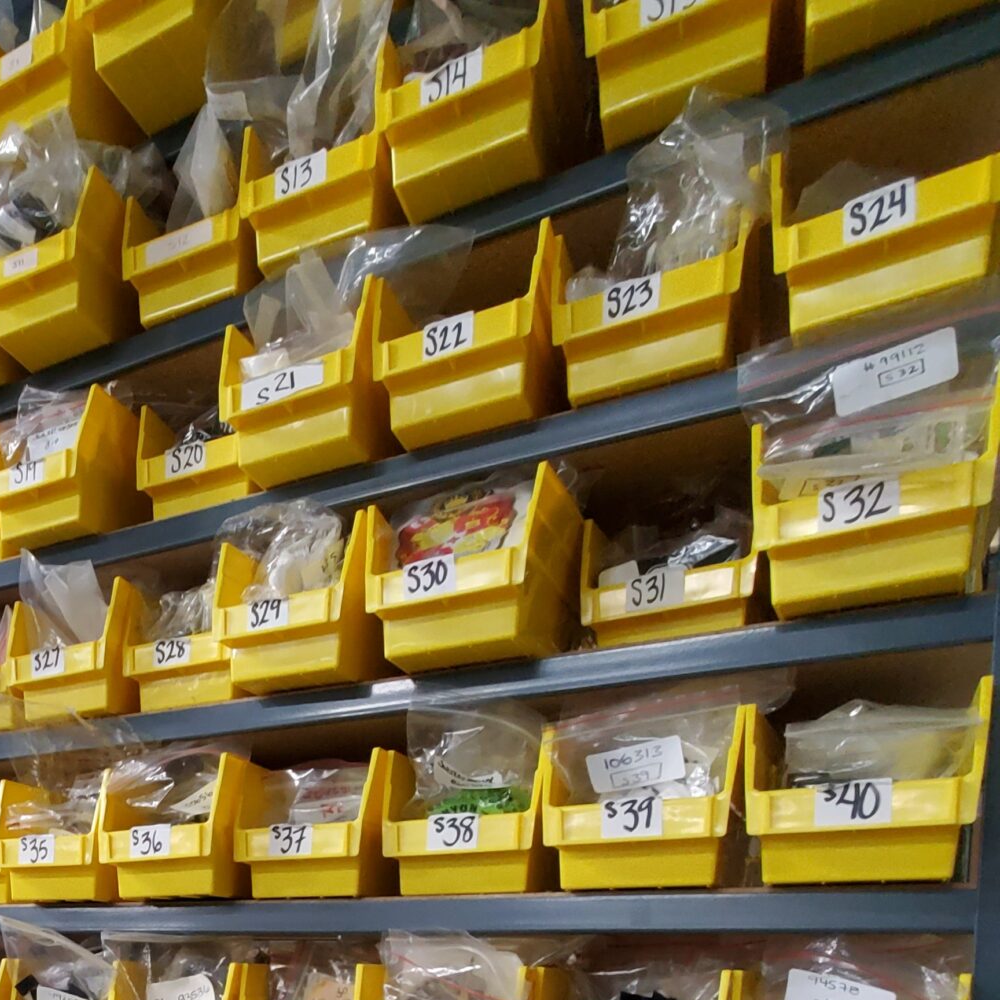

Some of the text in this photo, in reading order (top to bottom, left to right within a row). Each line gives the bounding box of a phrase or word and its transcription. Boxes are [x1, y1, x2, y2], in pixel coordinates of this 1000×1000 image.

[428, 58, 467, 102] S14
[281, 158, 312, 195] S13
[850, 184, 906, 237] S24
[607, 279, 653, 317] S23
[426, 325, 467, 356] S22
[256, 372, 295, 405] S21
[171, 443, 202, 473] S20
[822, 481, 891, 524] S32
[408, 559, 447, 594] S30
[631, 572, 664, 606] S31
[251, 599, 281, 628] S29
[35, 649, 60, 671] S27
[157, 641, 185, 664] S28
[603, 745, 663, 770] 106313
[605, 797, 653, 831] S39
[824, 783, 879, 819] S40
[133, 828, 162, 855] S36
[272, 826, 306, 854] S37
[435, 815, 475, 847] S38
[21, 836, 48, 863] S35
